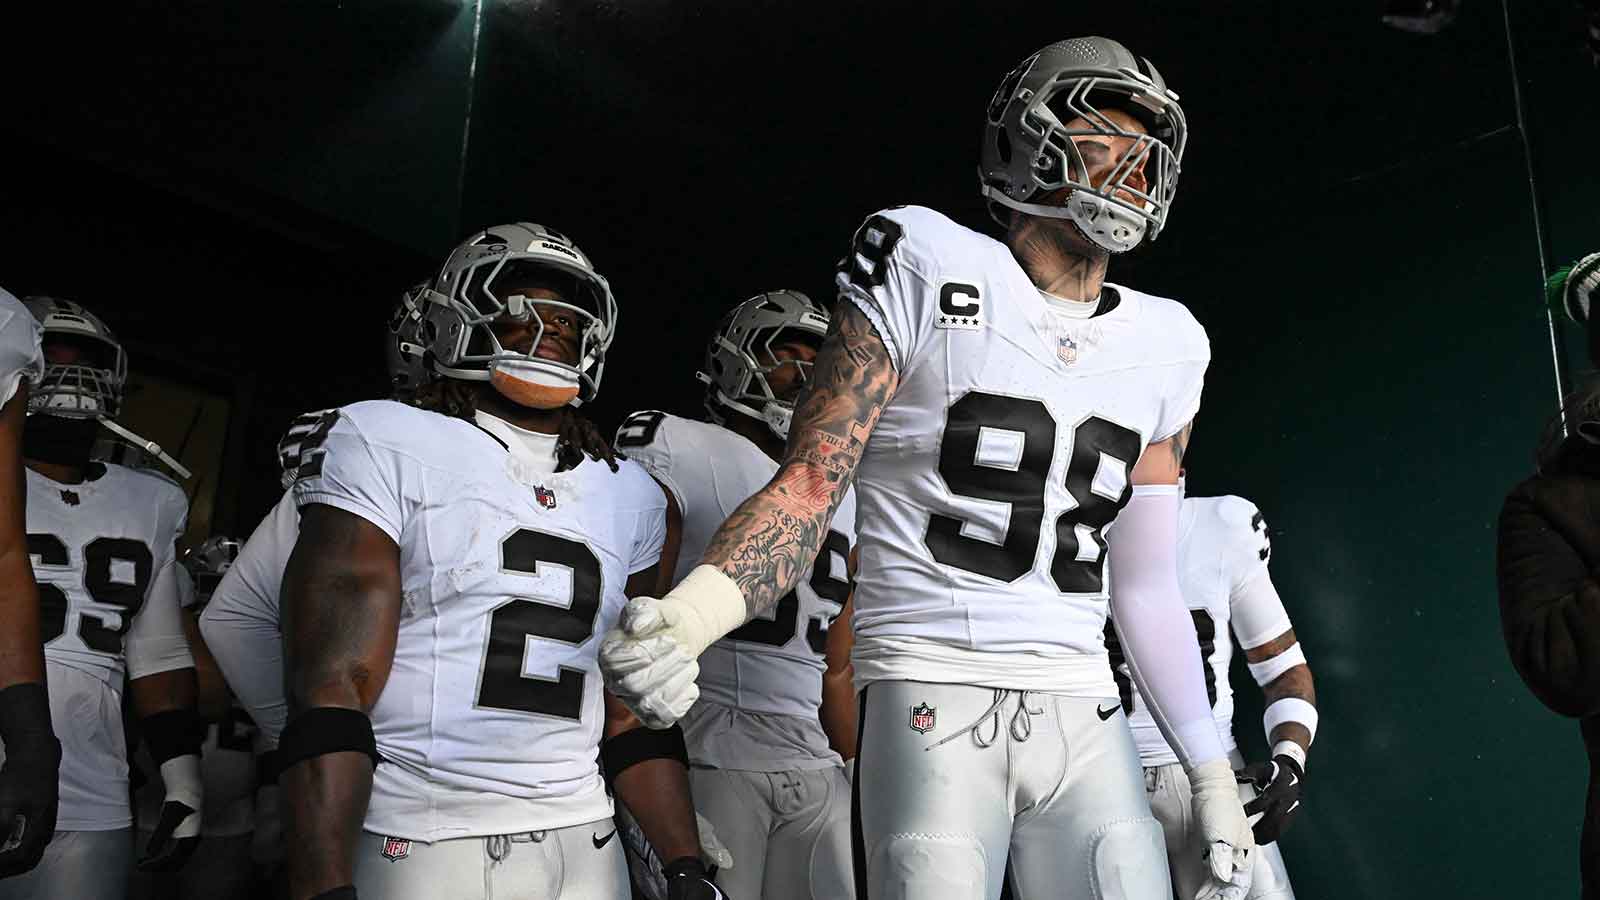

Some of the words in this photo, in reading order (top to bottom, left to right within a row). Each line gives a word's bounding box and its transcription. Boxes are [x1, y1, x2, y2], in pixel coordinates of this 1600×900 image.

[940, 282, 980, 316] C
[923, 389, 1142, 597] 98
[473, 525, 604, 724] 2
[914, 714, 934, 729] NFL
[386, 841, 408, 857] NFL
